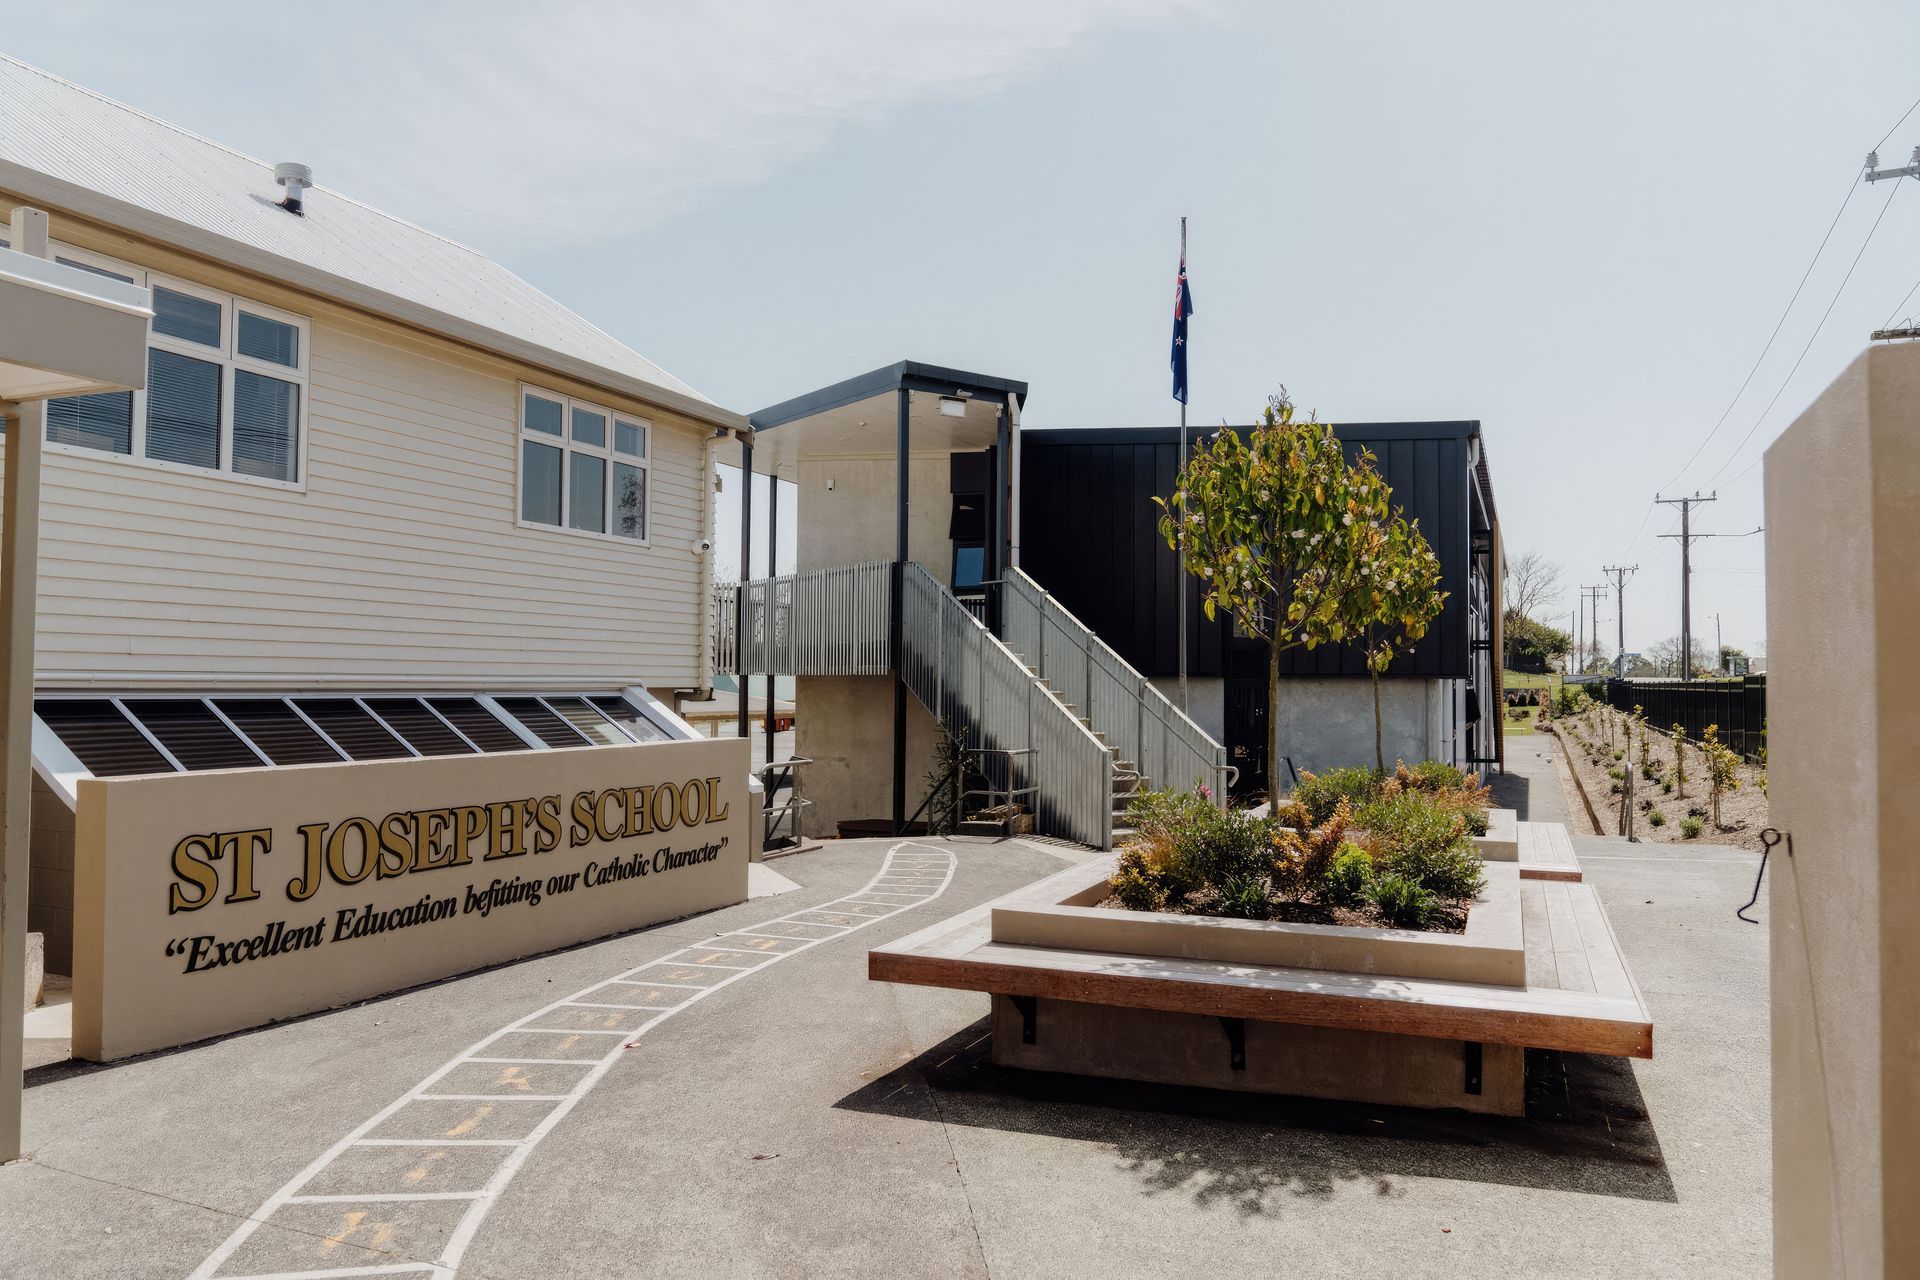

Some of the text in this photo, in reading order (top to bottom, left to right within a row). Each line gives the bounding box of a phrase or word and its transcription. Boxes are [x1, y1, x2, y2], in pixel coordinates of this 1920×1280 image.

[169, 777, 729, 915] ST JOSEPH’S SCHOOL
[330, 894, 457, 943] Education
[463, 876, 543, 917] befitting
[546, 871, 580, 896] our
[583, 853, 650, 888] Catholic
